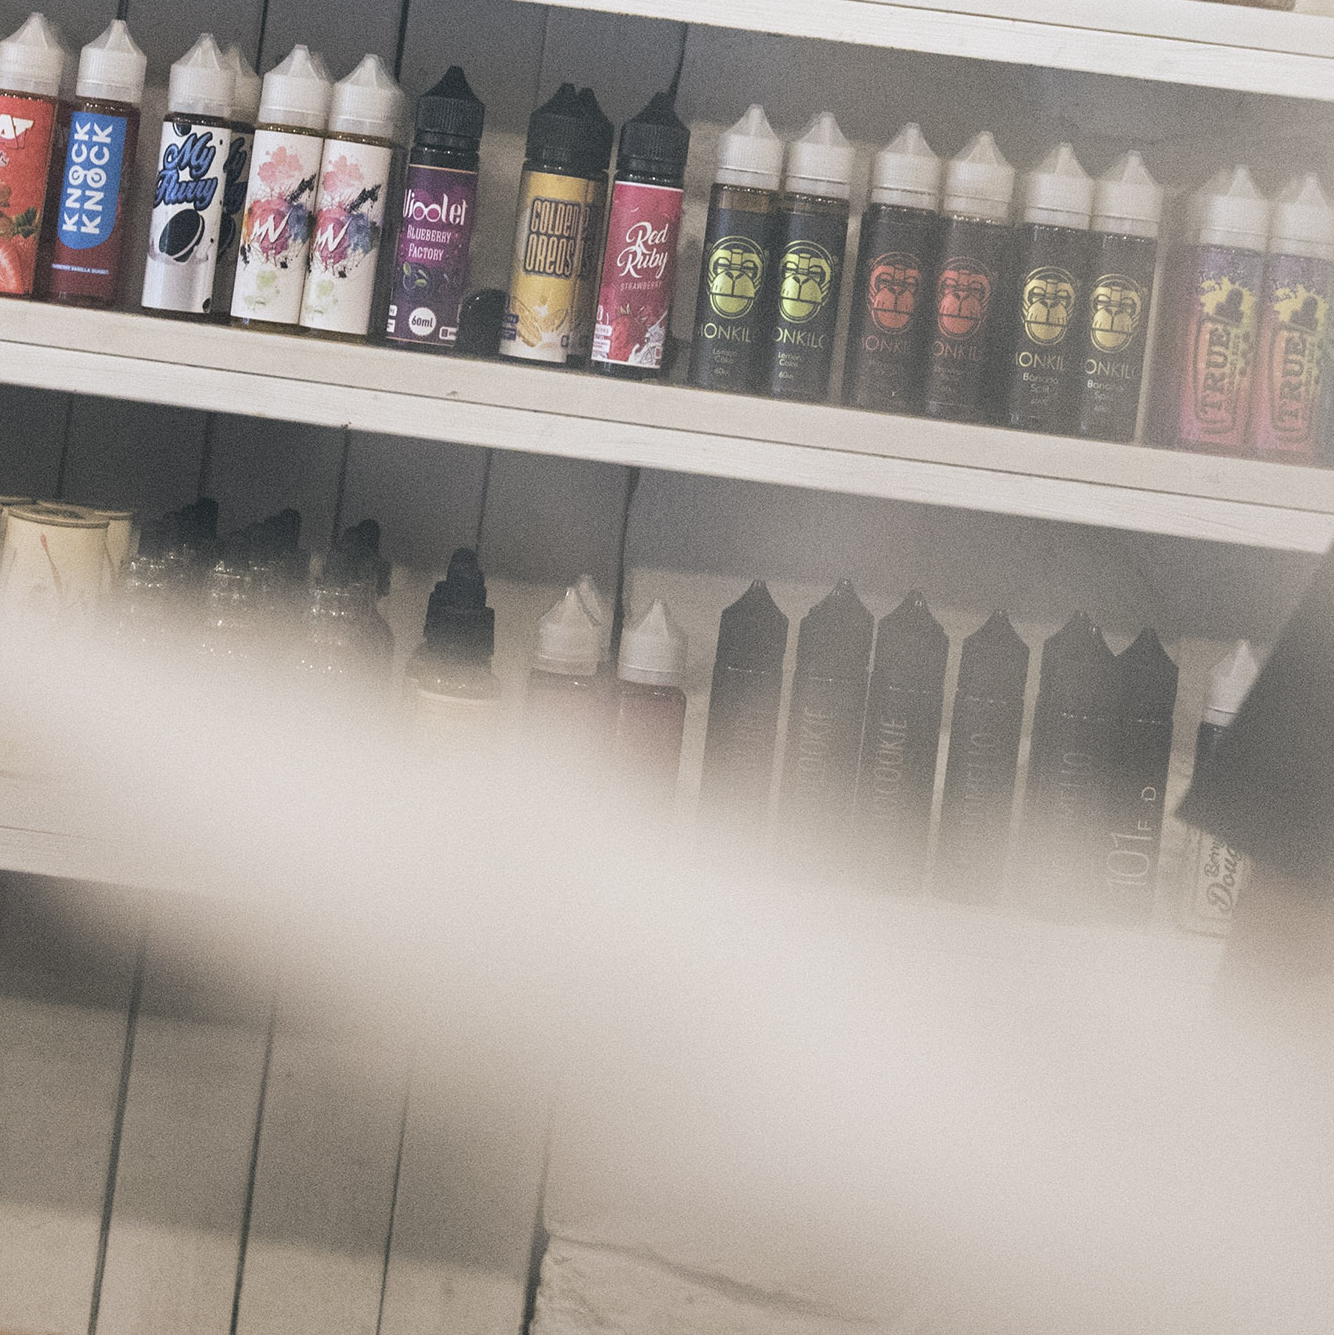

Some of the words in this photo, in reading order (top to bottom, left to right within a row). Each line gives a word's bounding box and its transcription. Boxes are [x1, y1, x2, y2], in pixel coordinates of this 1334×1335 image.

[62, 121, 91, 232] KNOCK
[163, 131, 216, 181] My
[80, 122, 113, 235] KNOCK
[407, 224, 452, 244] BLUEBERRY
[409, 243, 444, 262] FACTORY
[625, 221, 669, 254] Red
[617, 245, 669, 279] Ruby
[411, 315, 434, 329] 60ml
[1200, 326, 1231, 415] TRUE
[1277, 333, 1306, 423] TRUE
